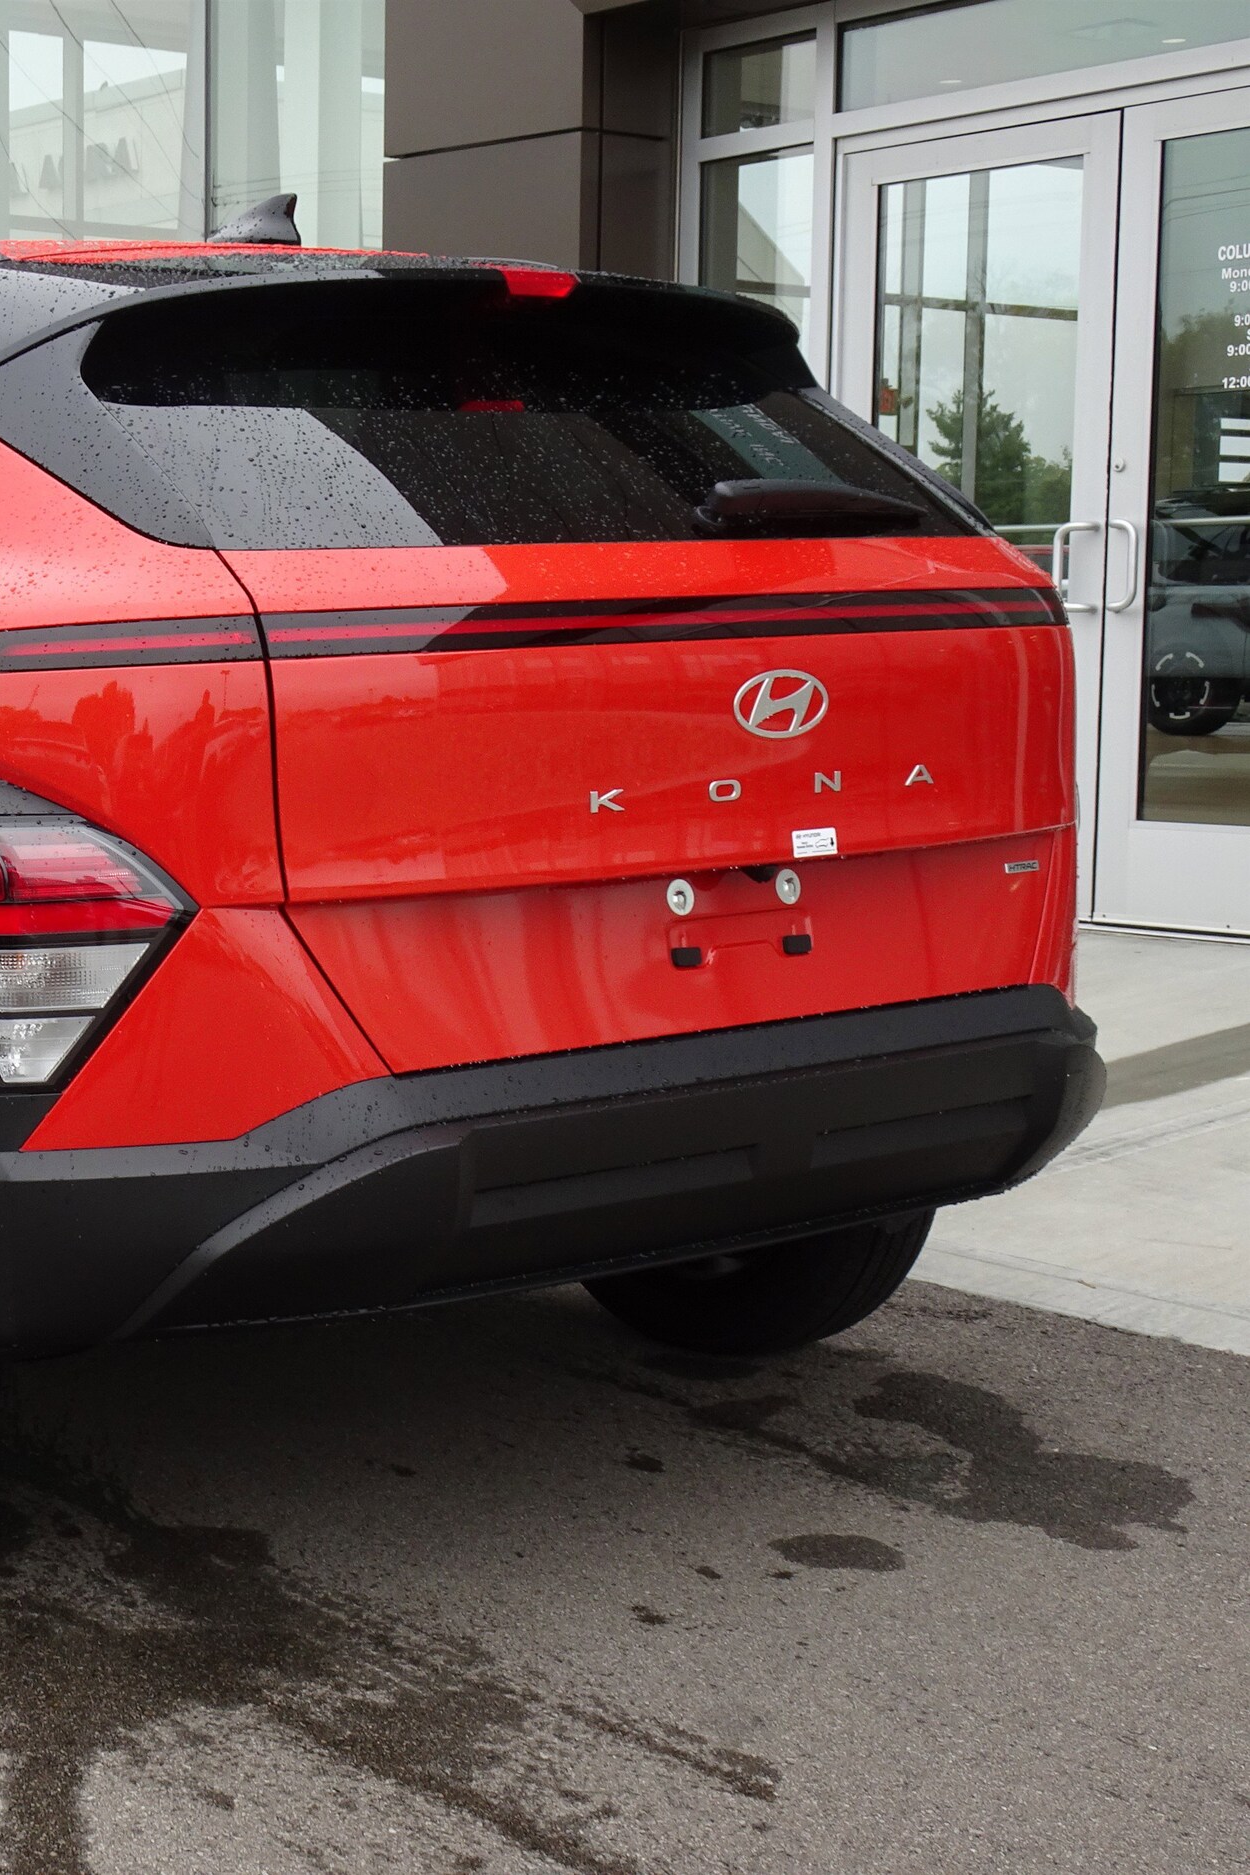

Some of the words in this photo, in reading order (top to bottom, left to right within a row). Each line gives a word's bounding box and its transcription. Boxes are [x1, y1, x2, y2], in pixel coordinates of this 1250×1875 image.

[1218, 243, 1250, 261] COLU
[1221, 267, 1250, 280] Mon
[1230, 279, 1250, 293] 9:0
[589, 763, 934, 814] KONA
[1008, 861, 1038, 872] HTRAC
